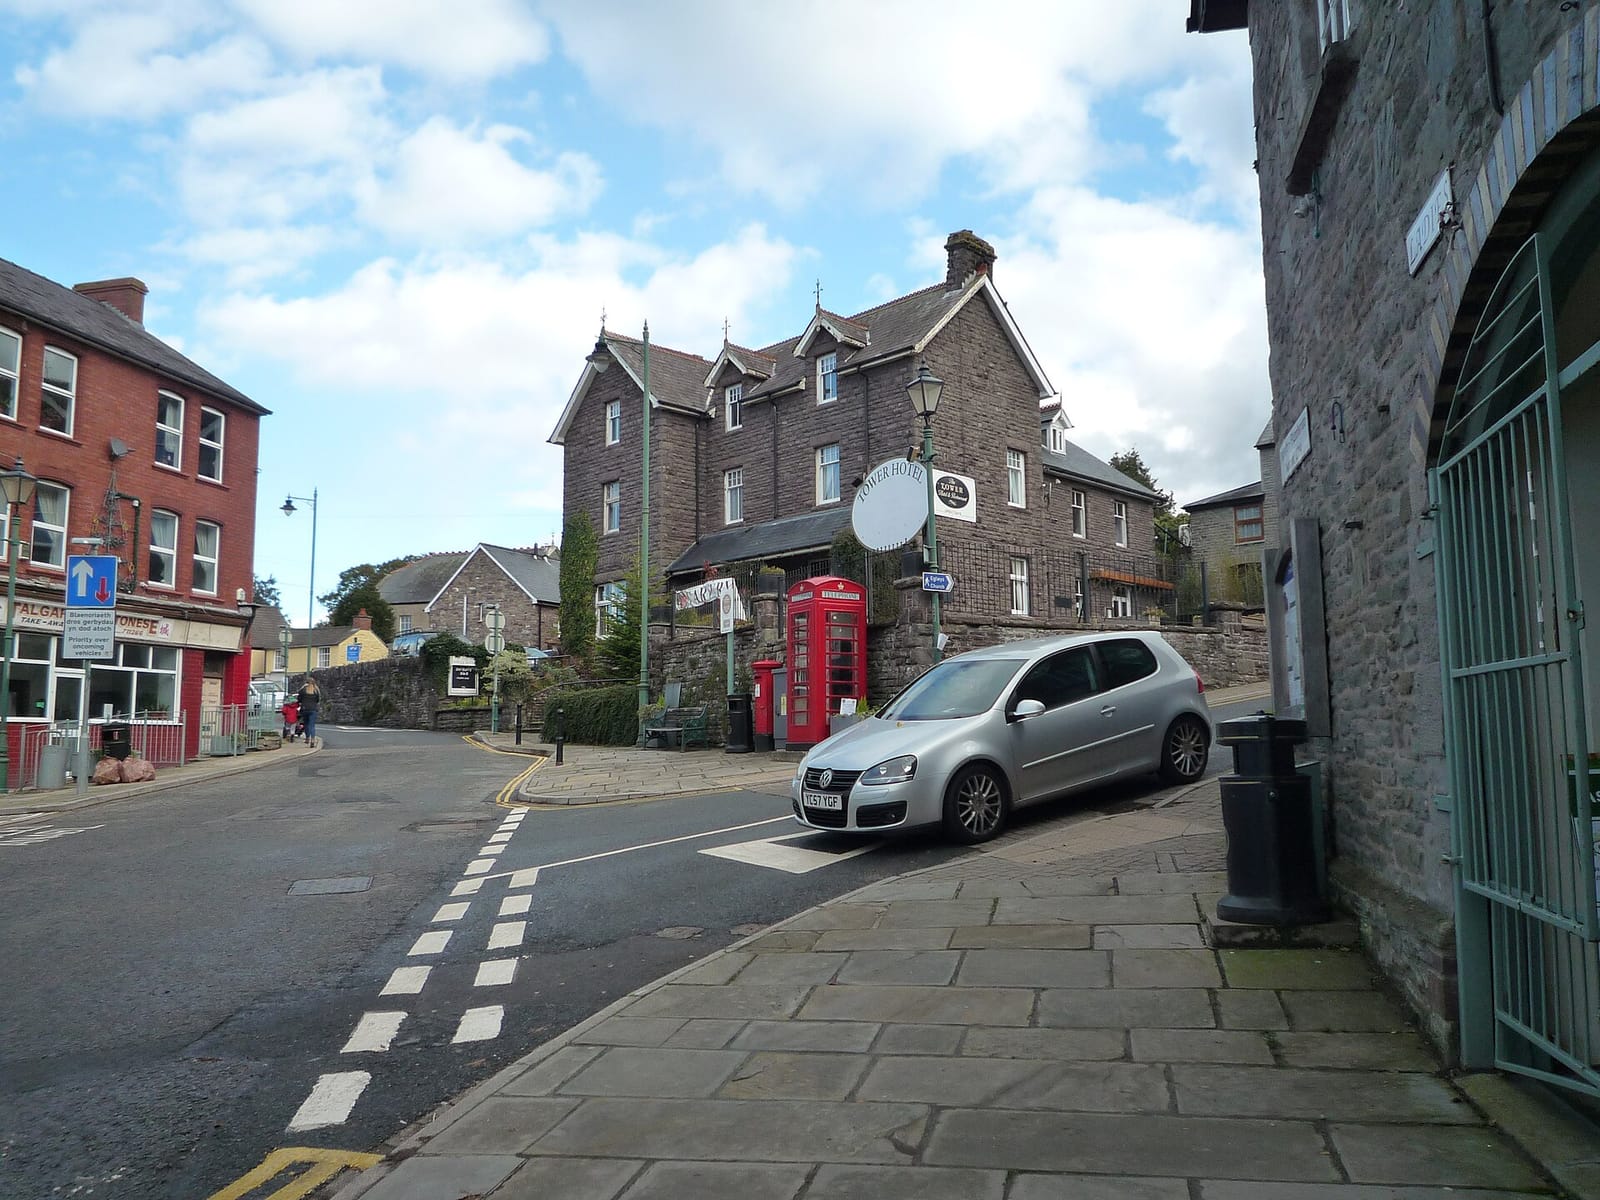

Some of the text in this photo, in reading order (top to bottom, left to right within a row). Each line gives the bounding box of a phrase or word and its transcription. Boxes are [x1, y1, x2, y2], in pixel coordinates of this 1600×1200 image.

[857, 461, 924, 504] TOWER HOTEL
[940, 482, 964, 494] TOWER
[21, 616, 63, 626] TAKE-AWA
[806, 794, 838, 807] YC57 YGF
